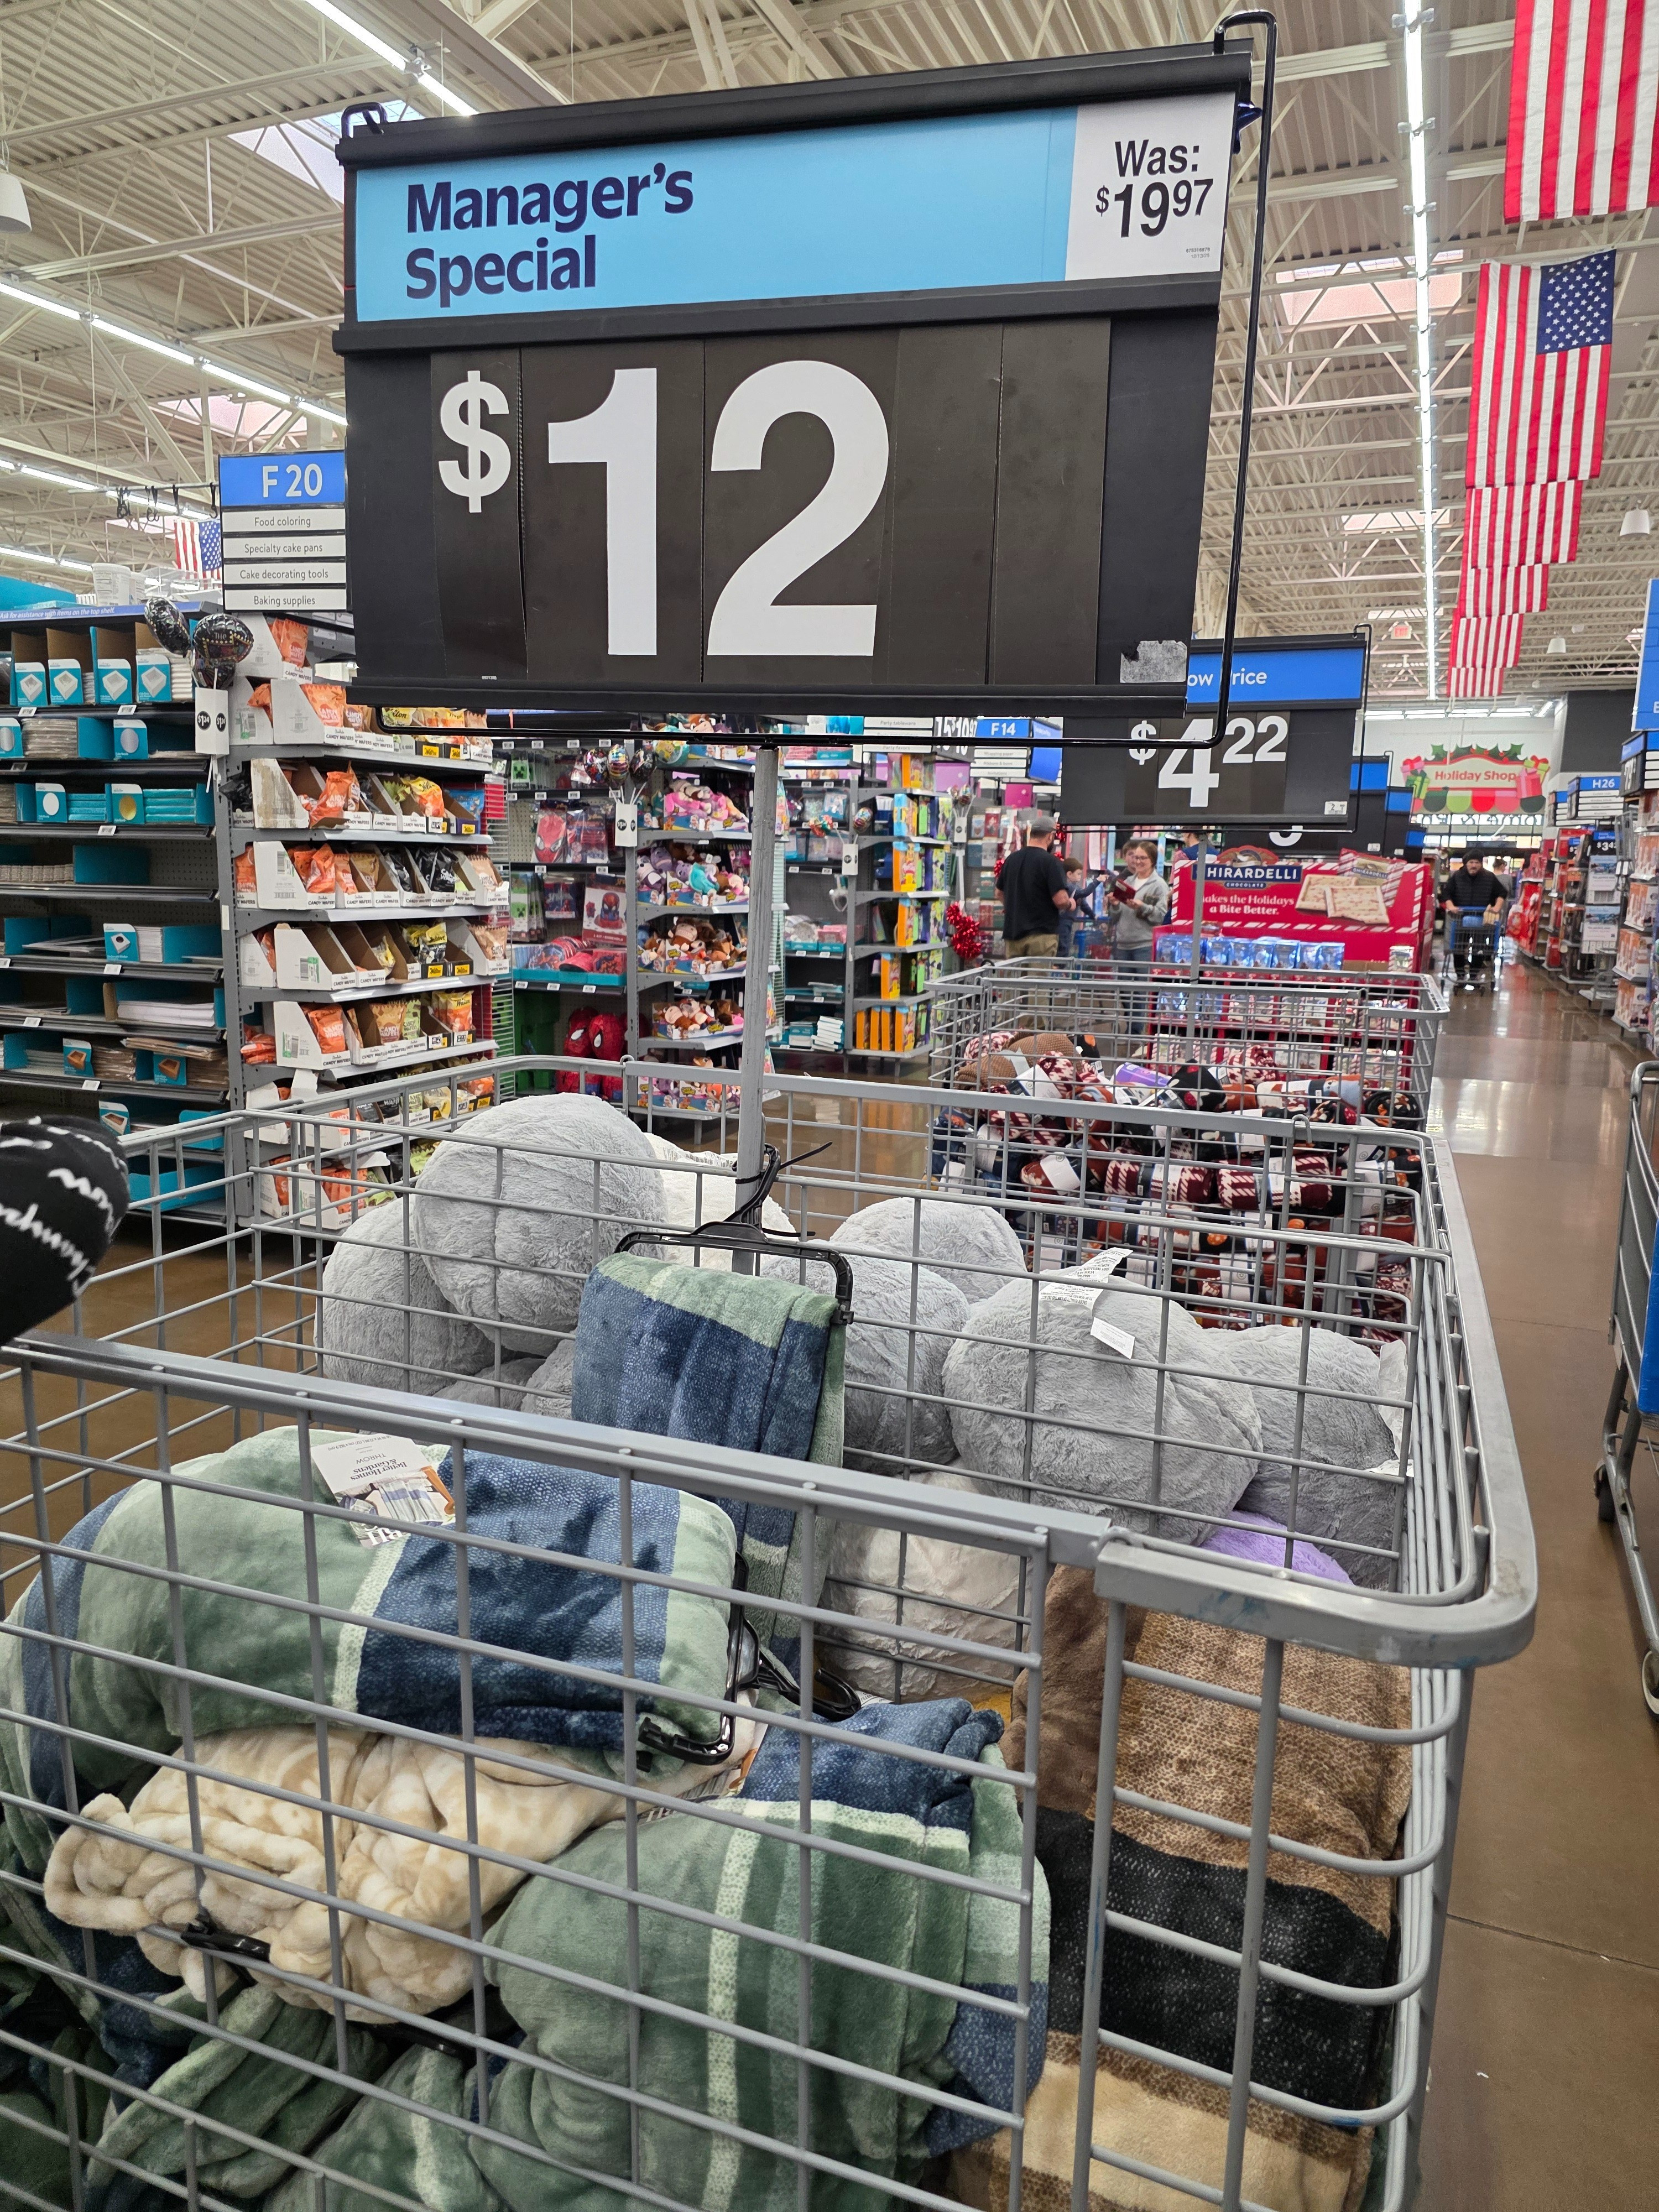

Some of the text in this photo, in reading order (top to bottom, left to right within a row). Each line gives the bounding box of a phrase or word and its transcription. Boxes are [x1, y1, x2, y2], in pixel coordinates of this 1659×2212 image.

[1115, 139, 1199, 177] Was:
[407, 162, 694, 233] Manager's
[406, 234, 596, 308] Special
[263, 463, 323, 498] F 20
[439, 360, 889, 656] $12
[254, 516, 311, 528] Food coloring
[244, 543, 323, 555] Specialty cake pans
[240, 568, 328, 581] Cake decorating tools
[254, 596, 316, 607] Baking supplies
[298, 672, 311, 681] WAFERS
[1187, 667, 1267, 686] ow rice
[991, 722, 1016, 735] F 14
[1129, 716, 1288, 807] $422
[1434, 770, 1517, 782] Holiday Shop
[1593, 779, 1615, 789] H26
[1208, 867, 1297, 879] HIRARDELLI
[1203, 894, 1294, 906] akes the Holidays
[1220, 905, 1241, 914] Bite
[1244, 905, 1279, 915] Better.
[356, 1453, 386, 1464] THROW
[350, 1461, 408, 1481] Better Homes
